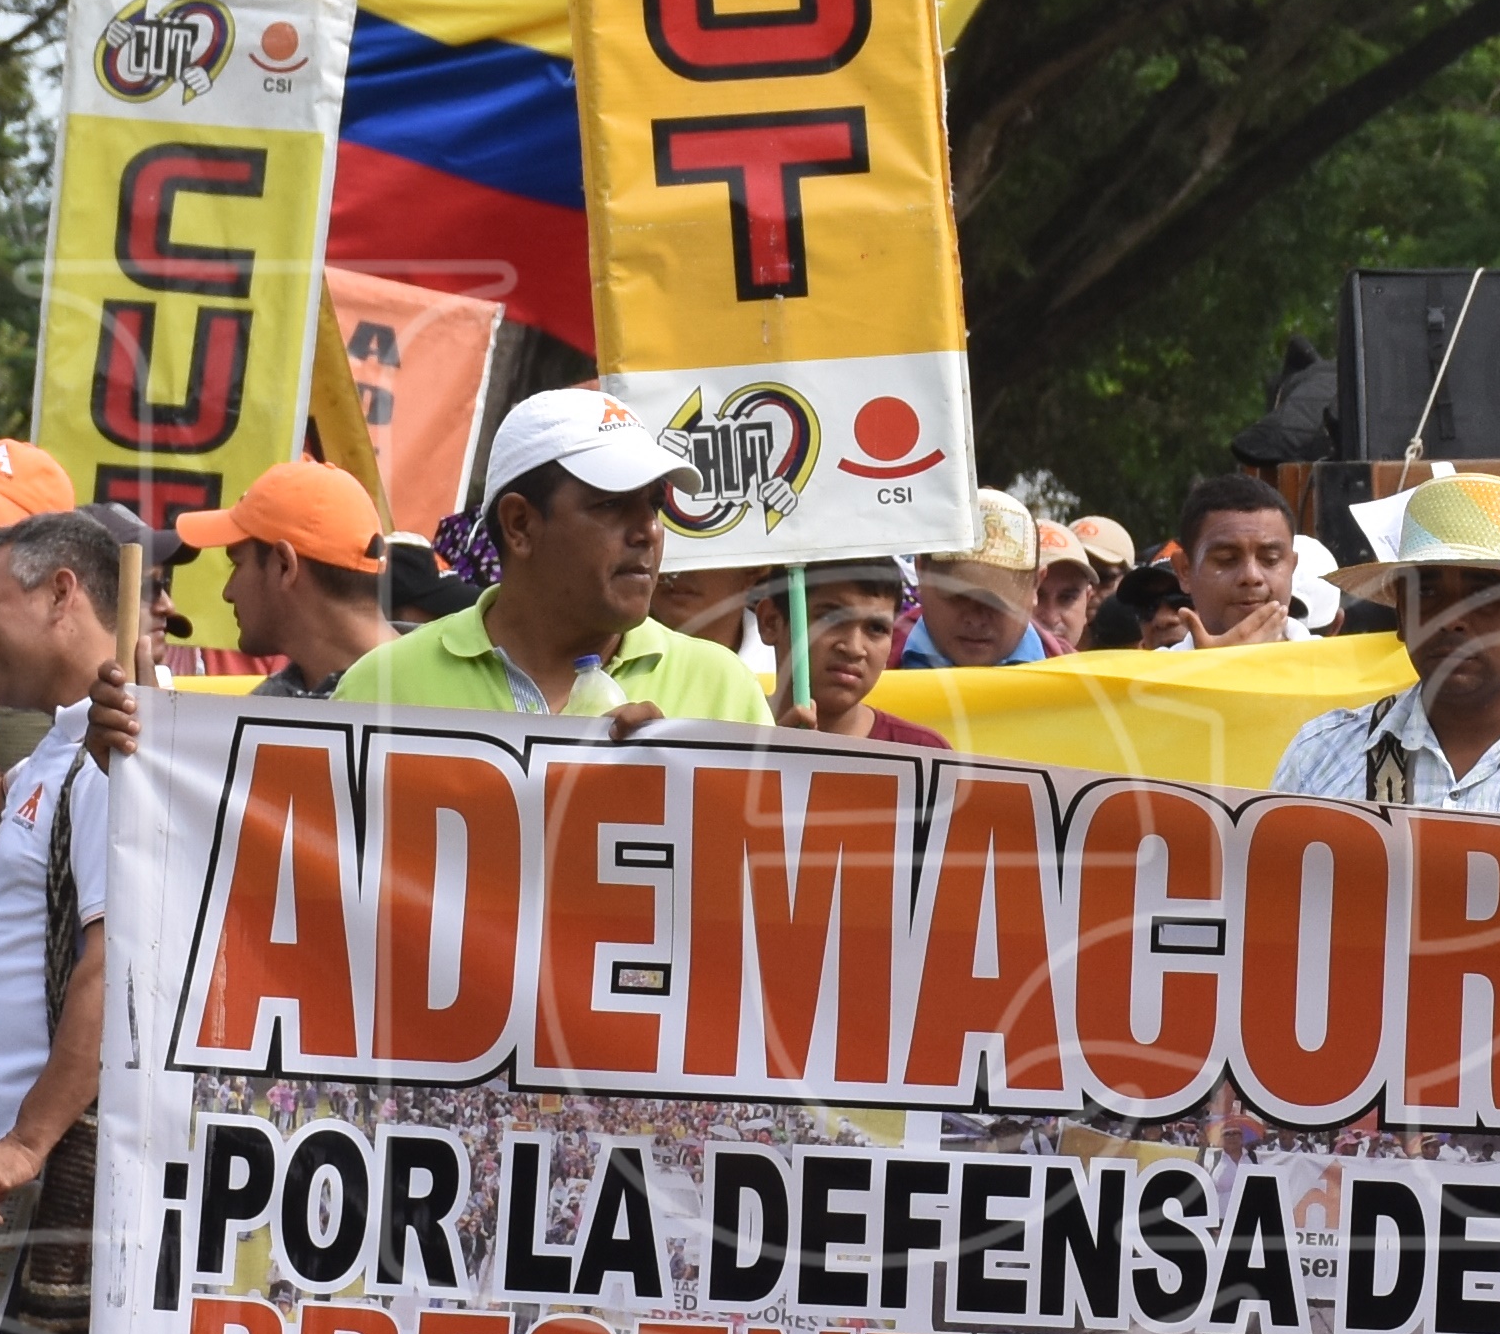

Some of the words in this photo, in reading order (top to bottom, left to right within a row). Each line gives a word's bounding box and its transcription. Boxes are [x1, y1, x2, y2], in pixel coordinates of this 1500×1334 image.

[263, 77, 293, 94] CSI
[876, 485, 913, 505] CSI
[503, 1141, 663, 1299] LA
[708, 1151, 1300, 1328] DEFENSA
